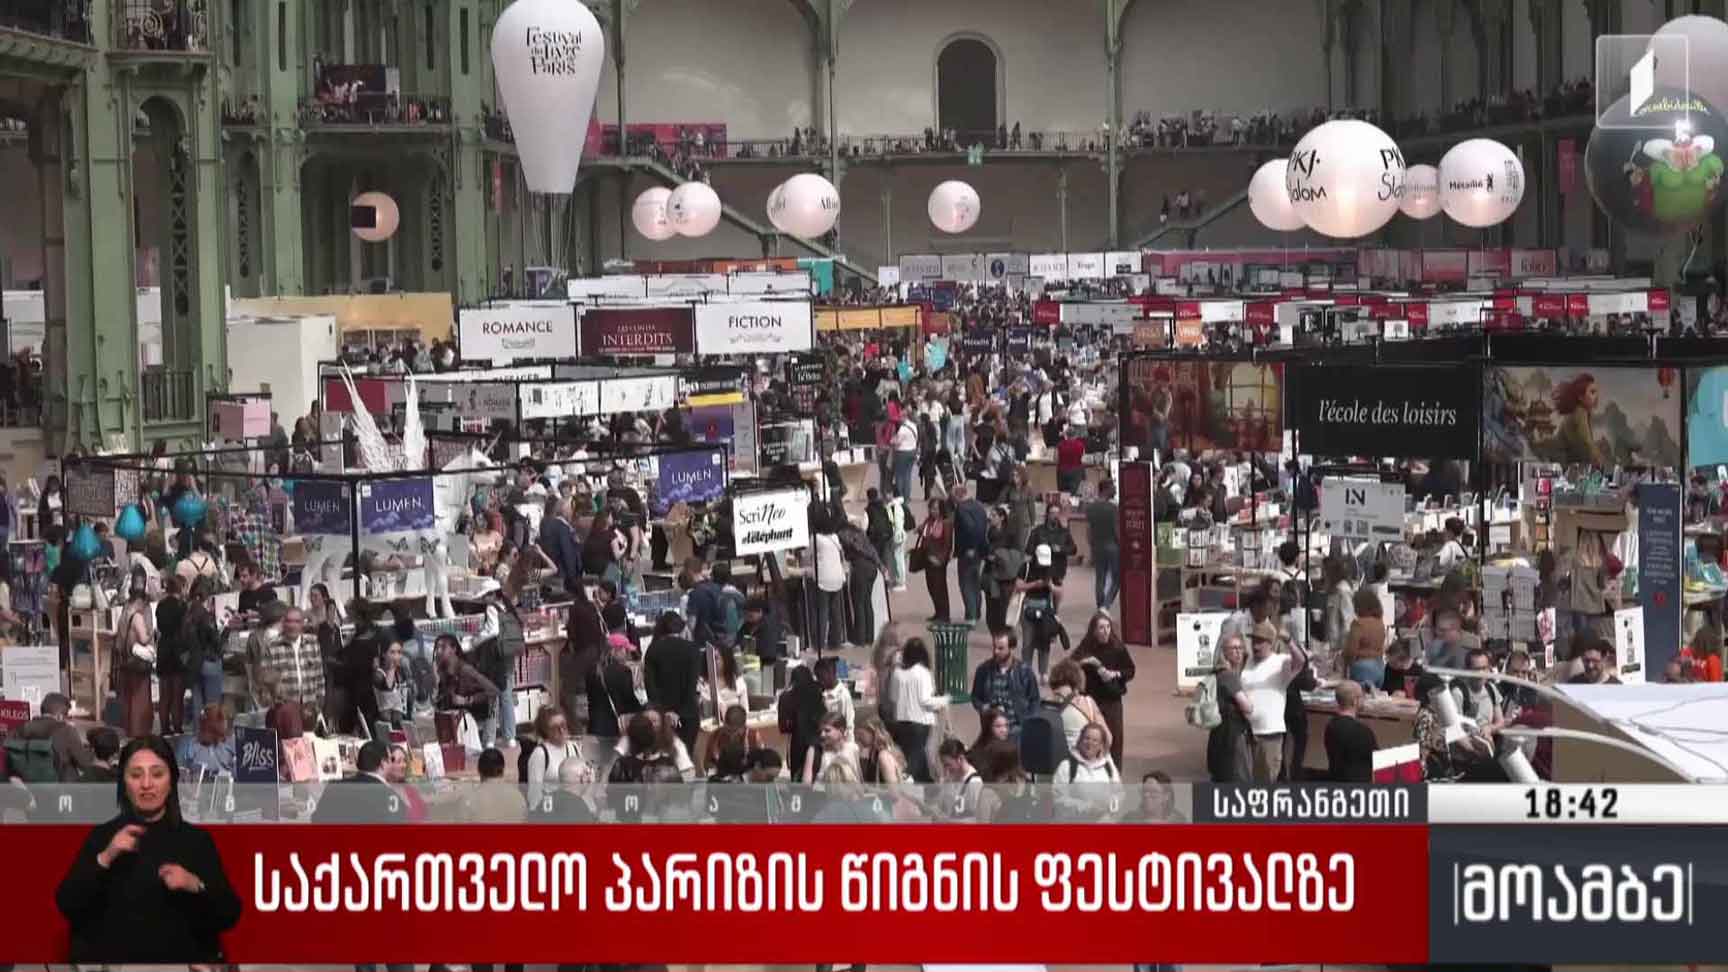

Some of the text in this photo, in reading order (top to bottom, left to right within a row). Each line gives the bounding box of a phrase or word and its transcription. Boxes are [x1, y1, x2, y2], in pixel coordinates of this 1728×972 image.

[482, 320, 553, 335] ROMANCE
[728, 315, 782, 329] FICTION
[602, 332, 673, 346] INTERDITS
[1371, 400, 1399, 424] des
[1403, 400, 1457, 425] loisirs
[671, 468, 712, 485] LUMEN
[304, 498, 340, 513] LUMEN
[375, 496, 422, 513] LUMEN
